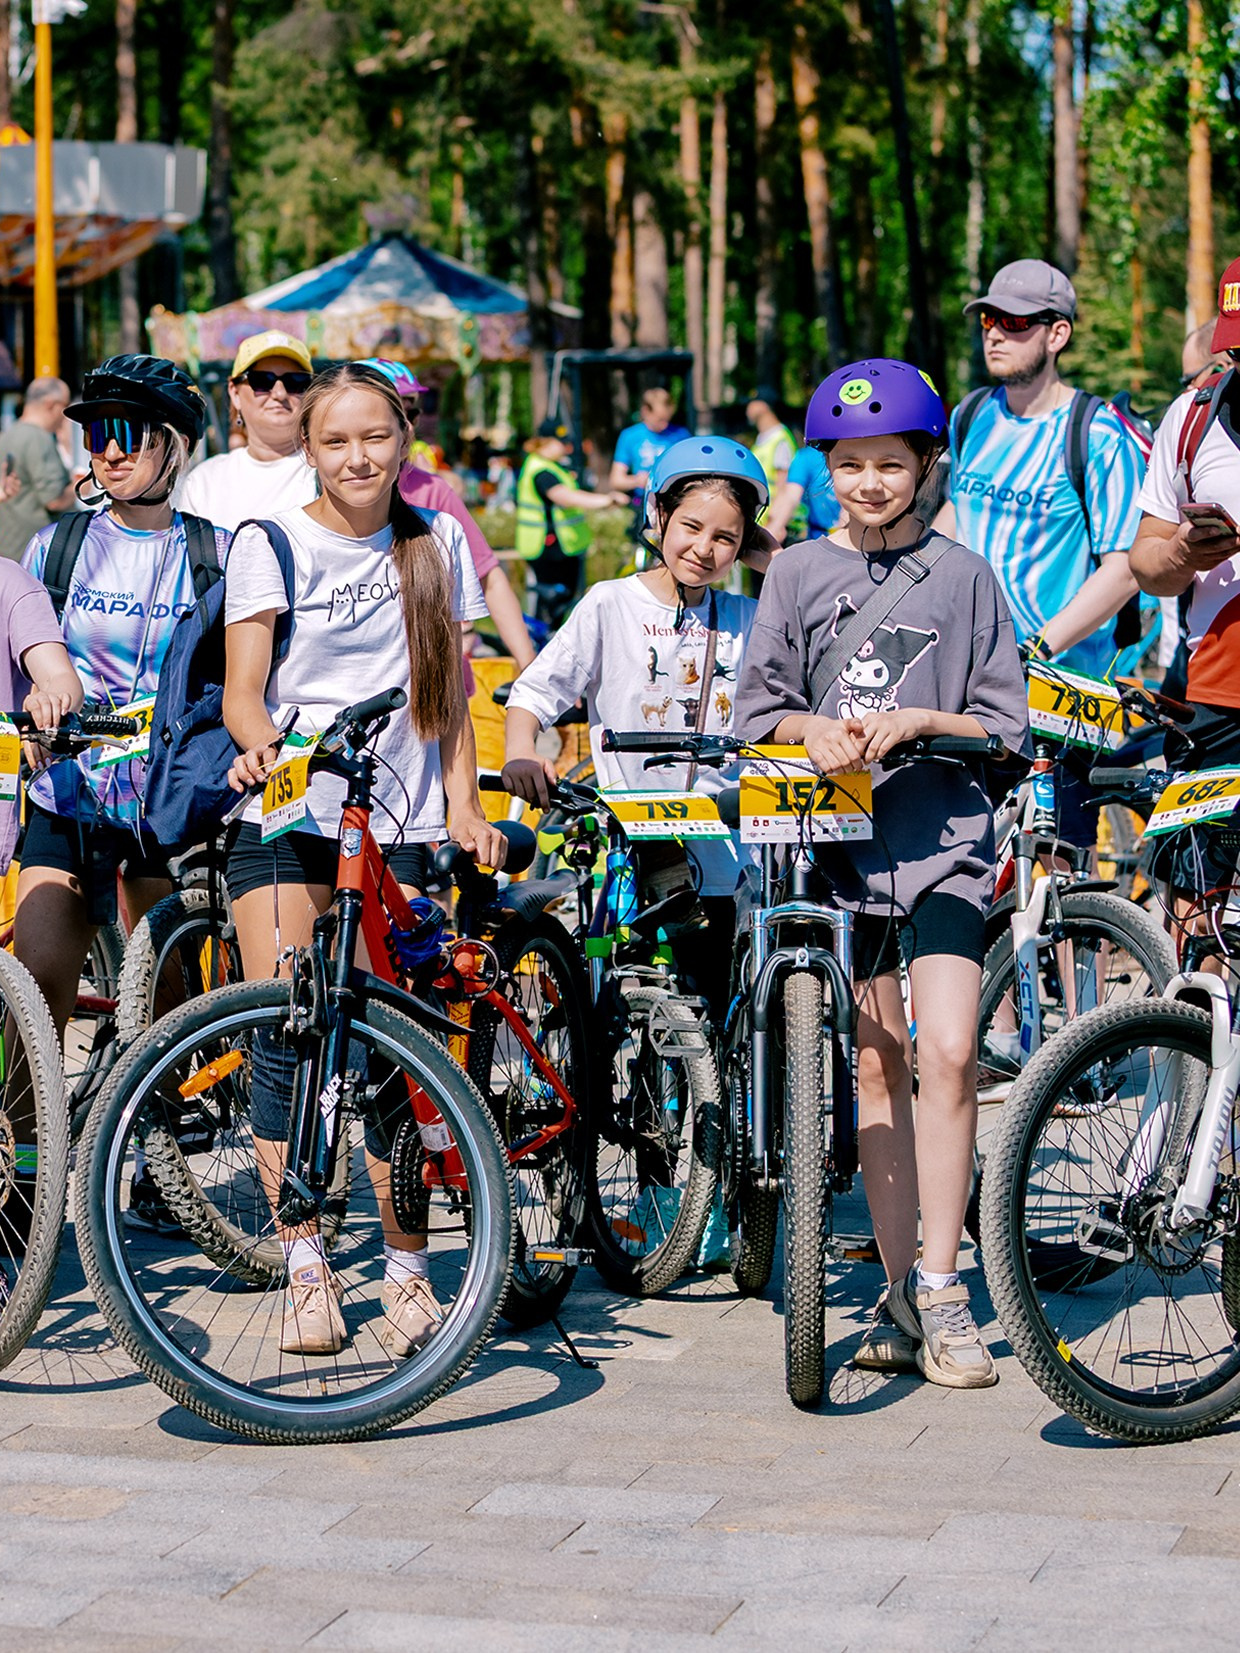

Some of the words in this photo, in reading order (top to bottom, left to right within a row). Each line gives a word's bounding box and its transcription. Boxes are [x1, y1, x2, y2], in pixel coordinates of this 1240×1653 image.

[955, 478, 1055, 510] АРАФОН
[71, 592, 192, 620] МАРАФО
[270, 765, 294, 808] 735
[775, 780, 837, 812] 152
[1177, 778, 1236, 805] 682
[636, 801, 689, 819] 719
[1019, 960, 1034, 1019] XCT
